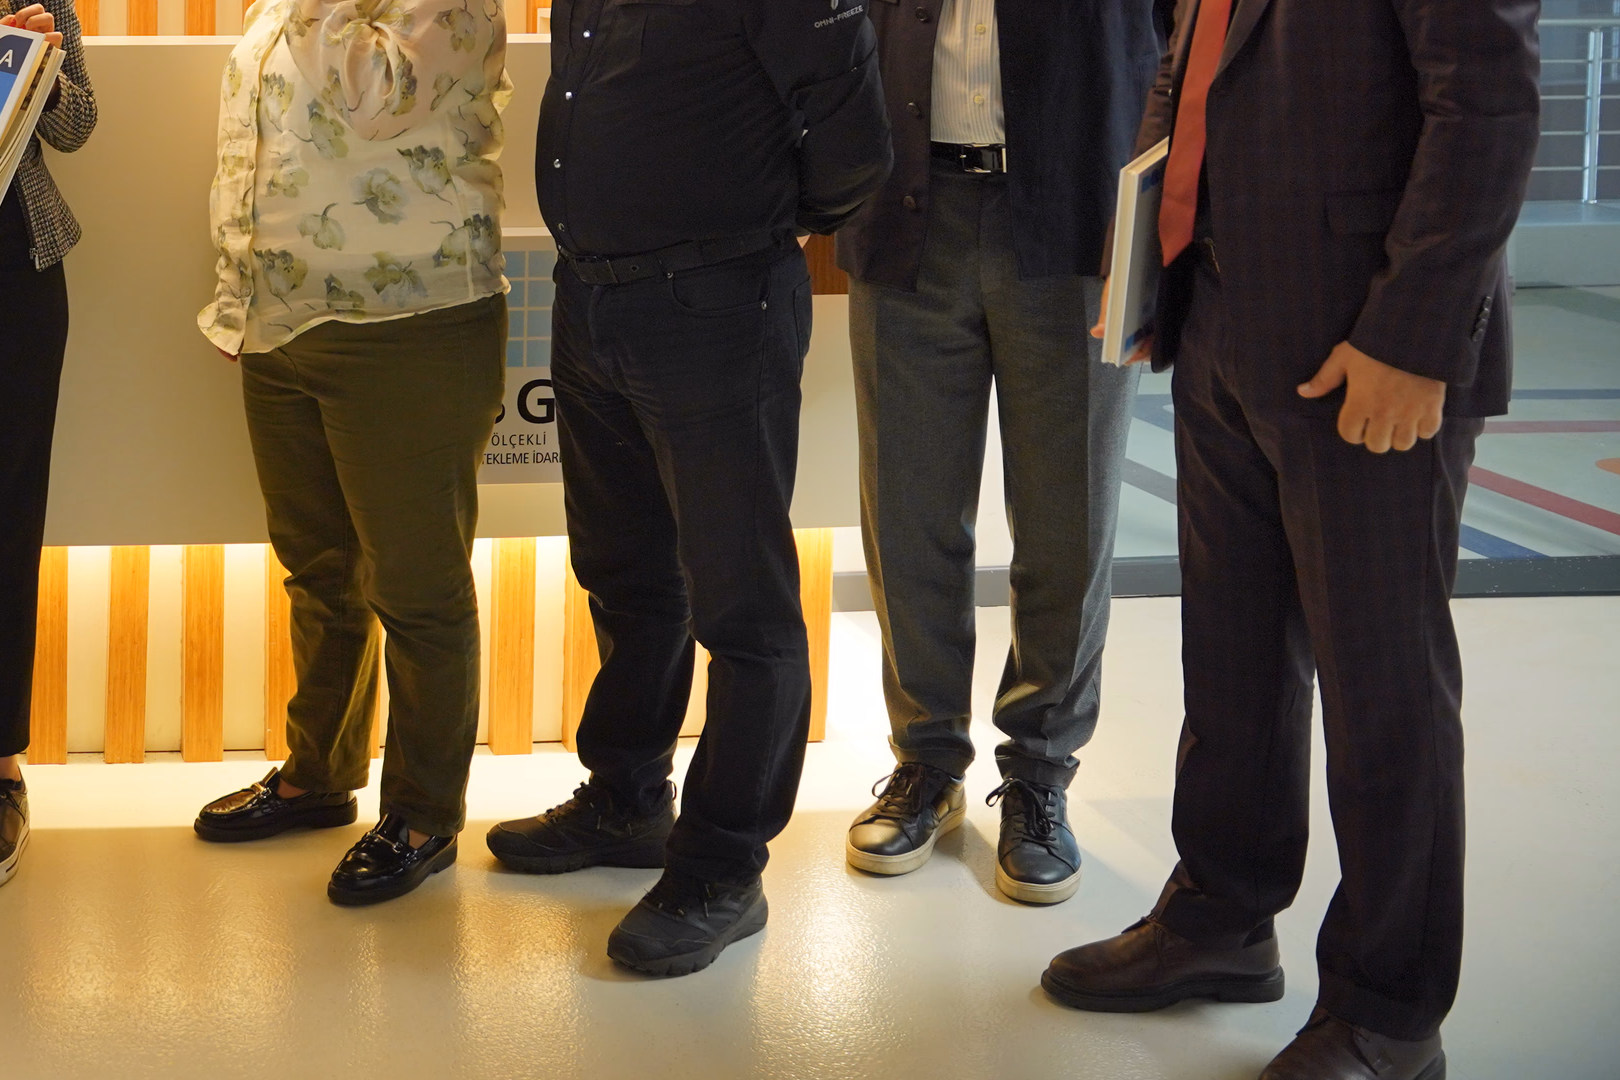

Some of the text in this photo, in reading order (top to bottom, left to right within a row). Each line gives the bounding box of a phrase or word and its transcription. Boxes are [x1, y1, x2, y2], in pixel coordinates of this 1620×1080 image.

[814, 4, 864, 28] OMNI-FREEZE
[491, 431, 546, 449] ÖLÇEKLİ
[532, 450, 562, 464] İDAR
